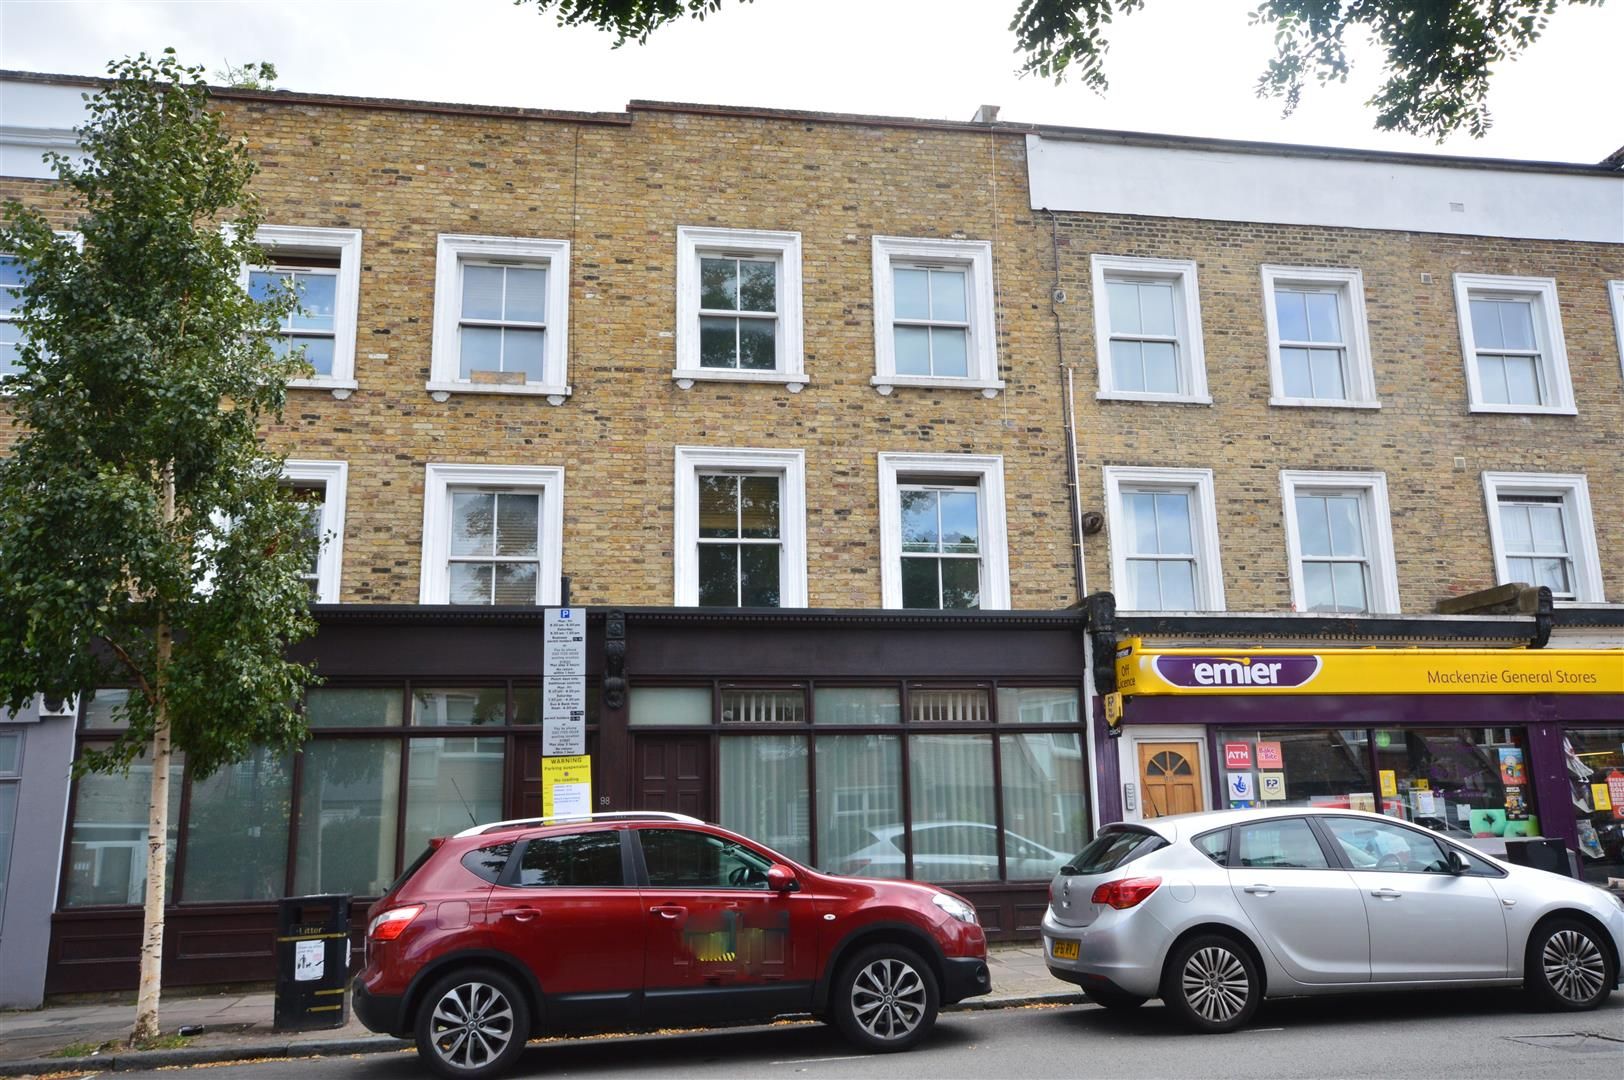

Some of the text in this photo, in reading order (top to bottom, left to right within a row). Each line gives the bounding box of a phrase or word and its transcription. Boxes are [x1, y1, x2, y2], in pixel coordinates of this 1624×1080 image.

[1122, 664, 1130, 676] Off
[1427, 670, 1597, 684] Mackenzie General Stores
